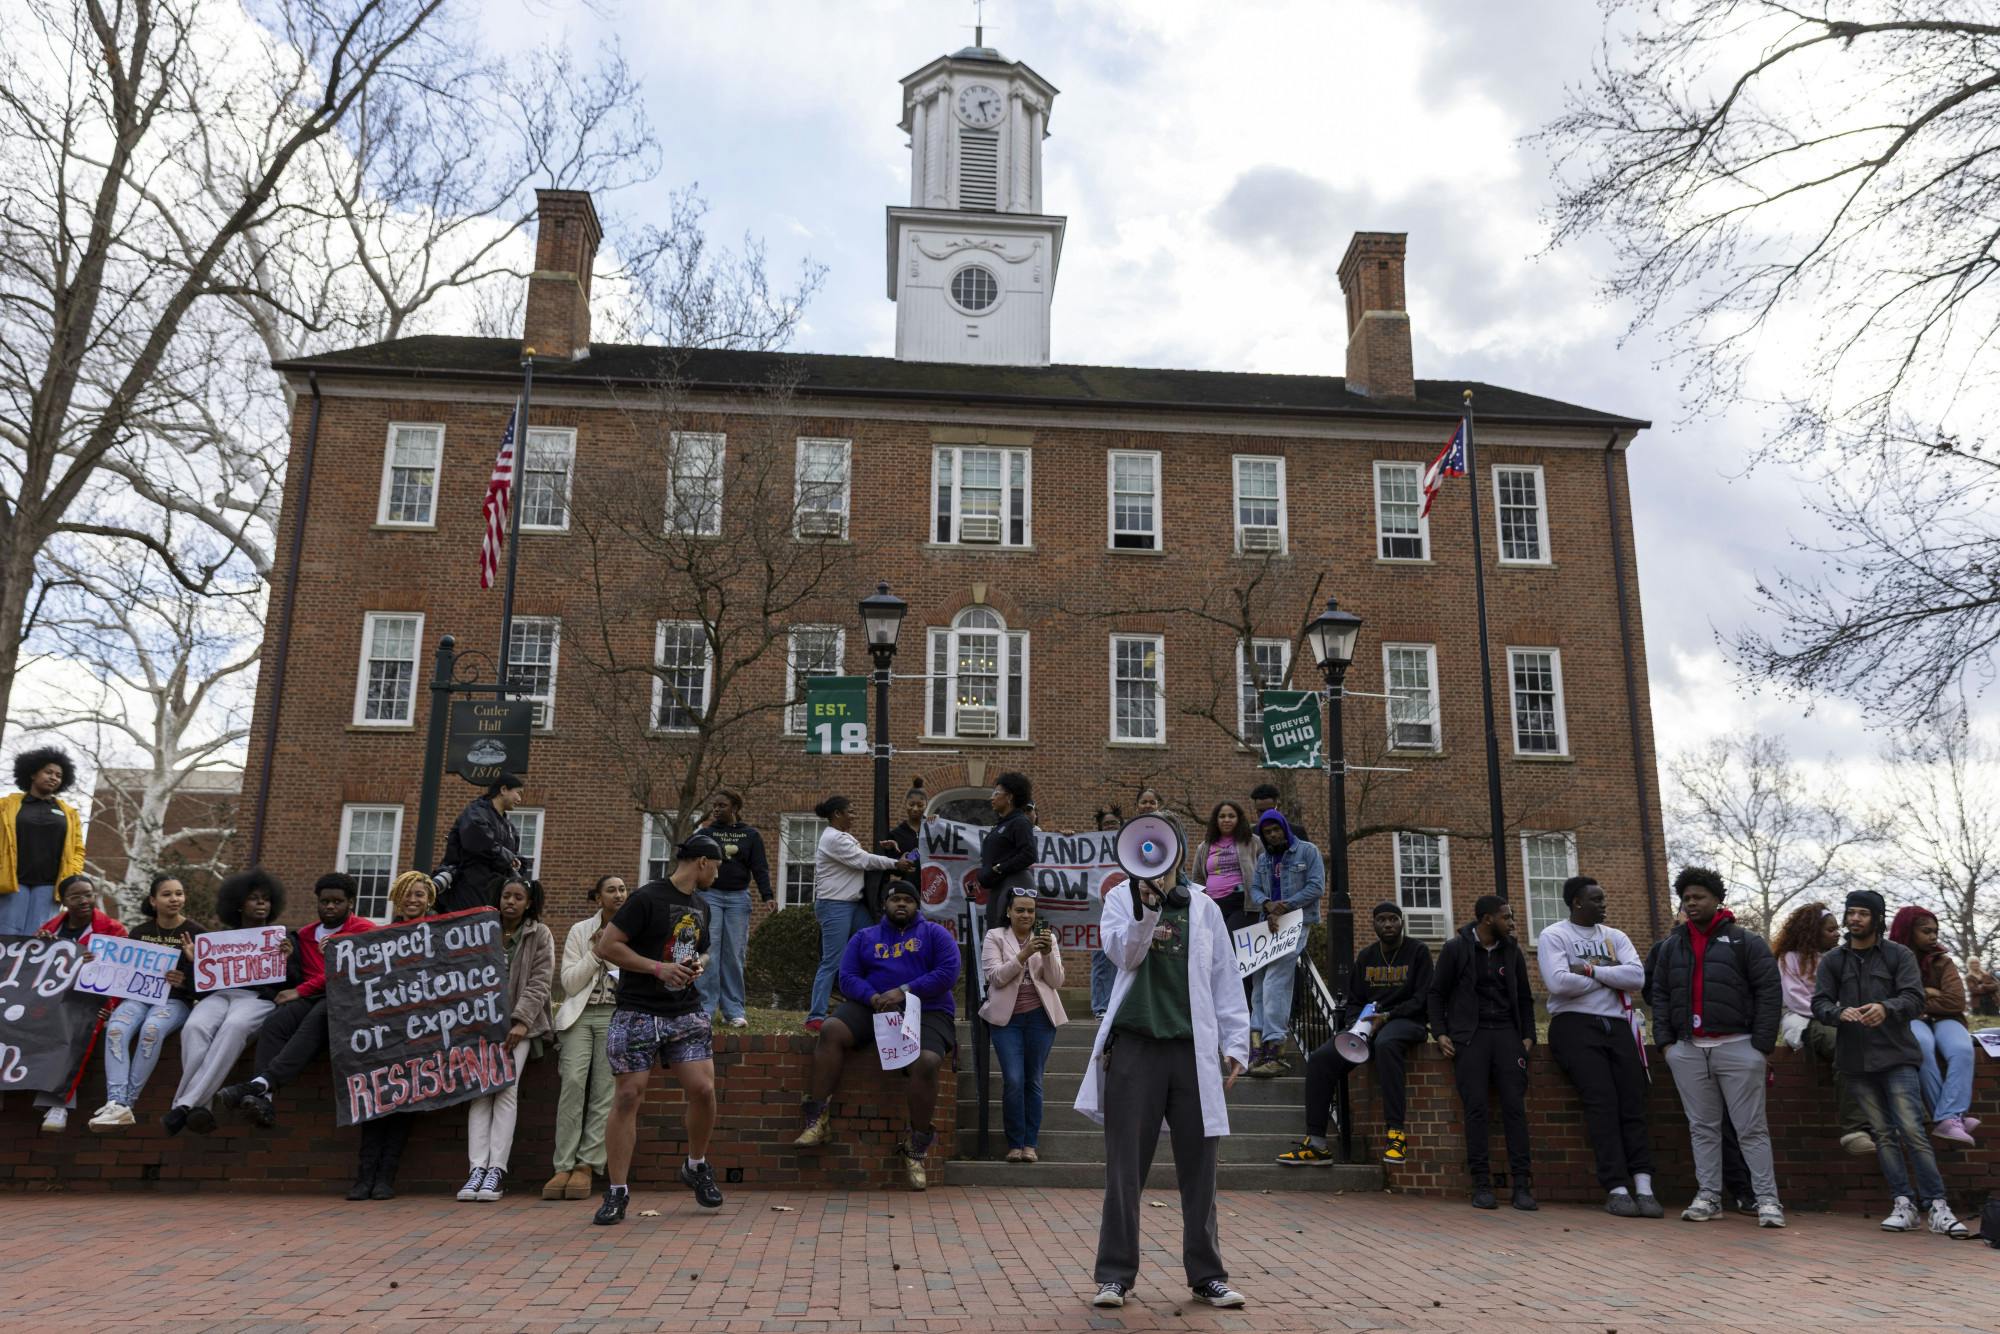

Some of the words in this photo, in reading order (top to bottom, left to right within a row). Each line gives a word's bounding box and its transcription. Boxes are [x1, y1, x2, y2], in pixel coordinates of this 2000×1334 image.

[474, 705, 509, 716] Cutler
[479, 720, 502, 731] Hall
[815, 703, 851, 716] EST.
[1270, 715, 1310, 732] FOREVER
[815, 722, 868, 754] 18
[1273, 725, 1315, 748] OHIO
[471, 766, 502, 778] 1816
[923, 822, 969, 855] WE
[91, 938, 178, 972] PROTECT
[335, 922, 435, 985] Respect
[444, 920, 500, 951] our
[1237, 931, 1267, 958] 40
[79, 963, 127, 993] OUR
[127, 972, 167, 999] DEI
[197, 950, 288, 990] STENGTH
[364, 964, 500, 1013] Existence
[350, 1024, 391, 1053] or
[406, 990, 503, 1050] expect
